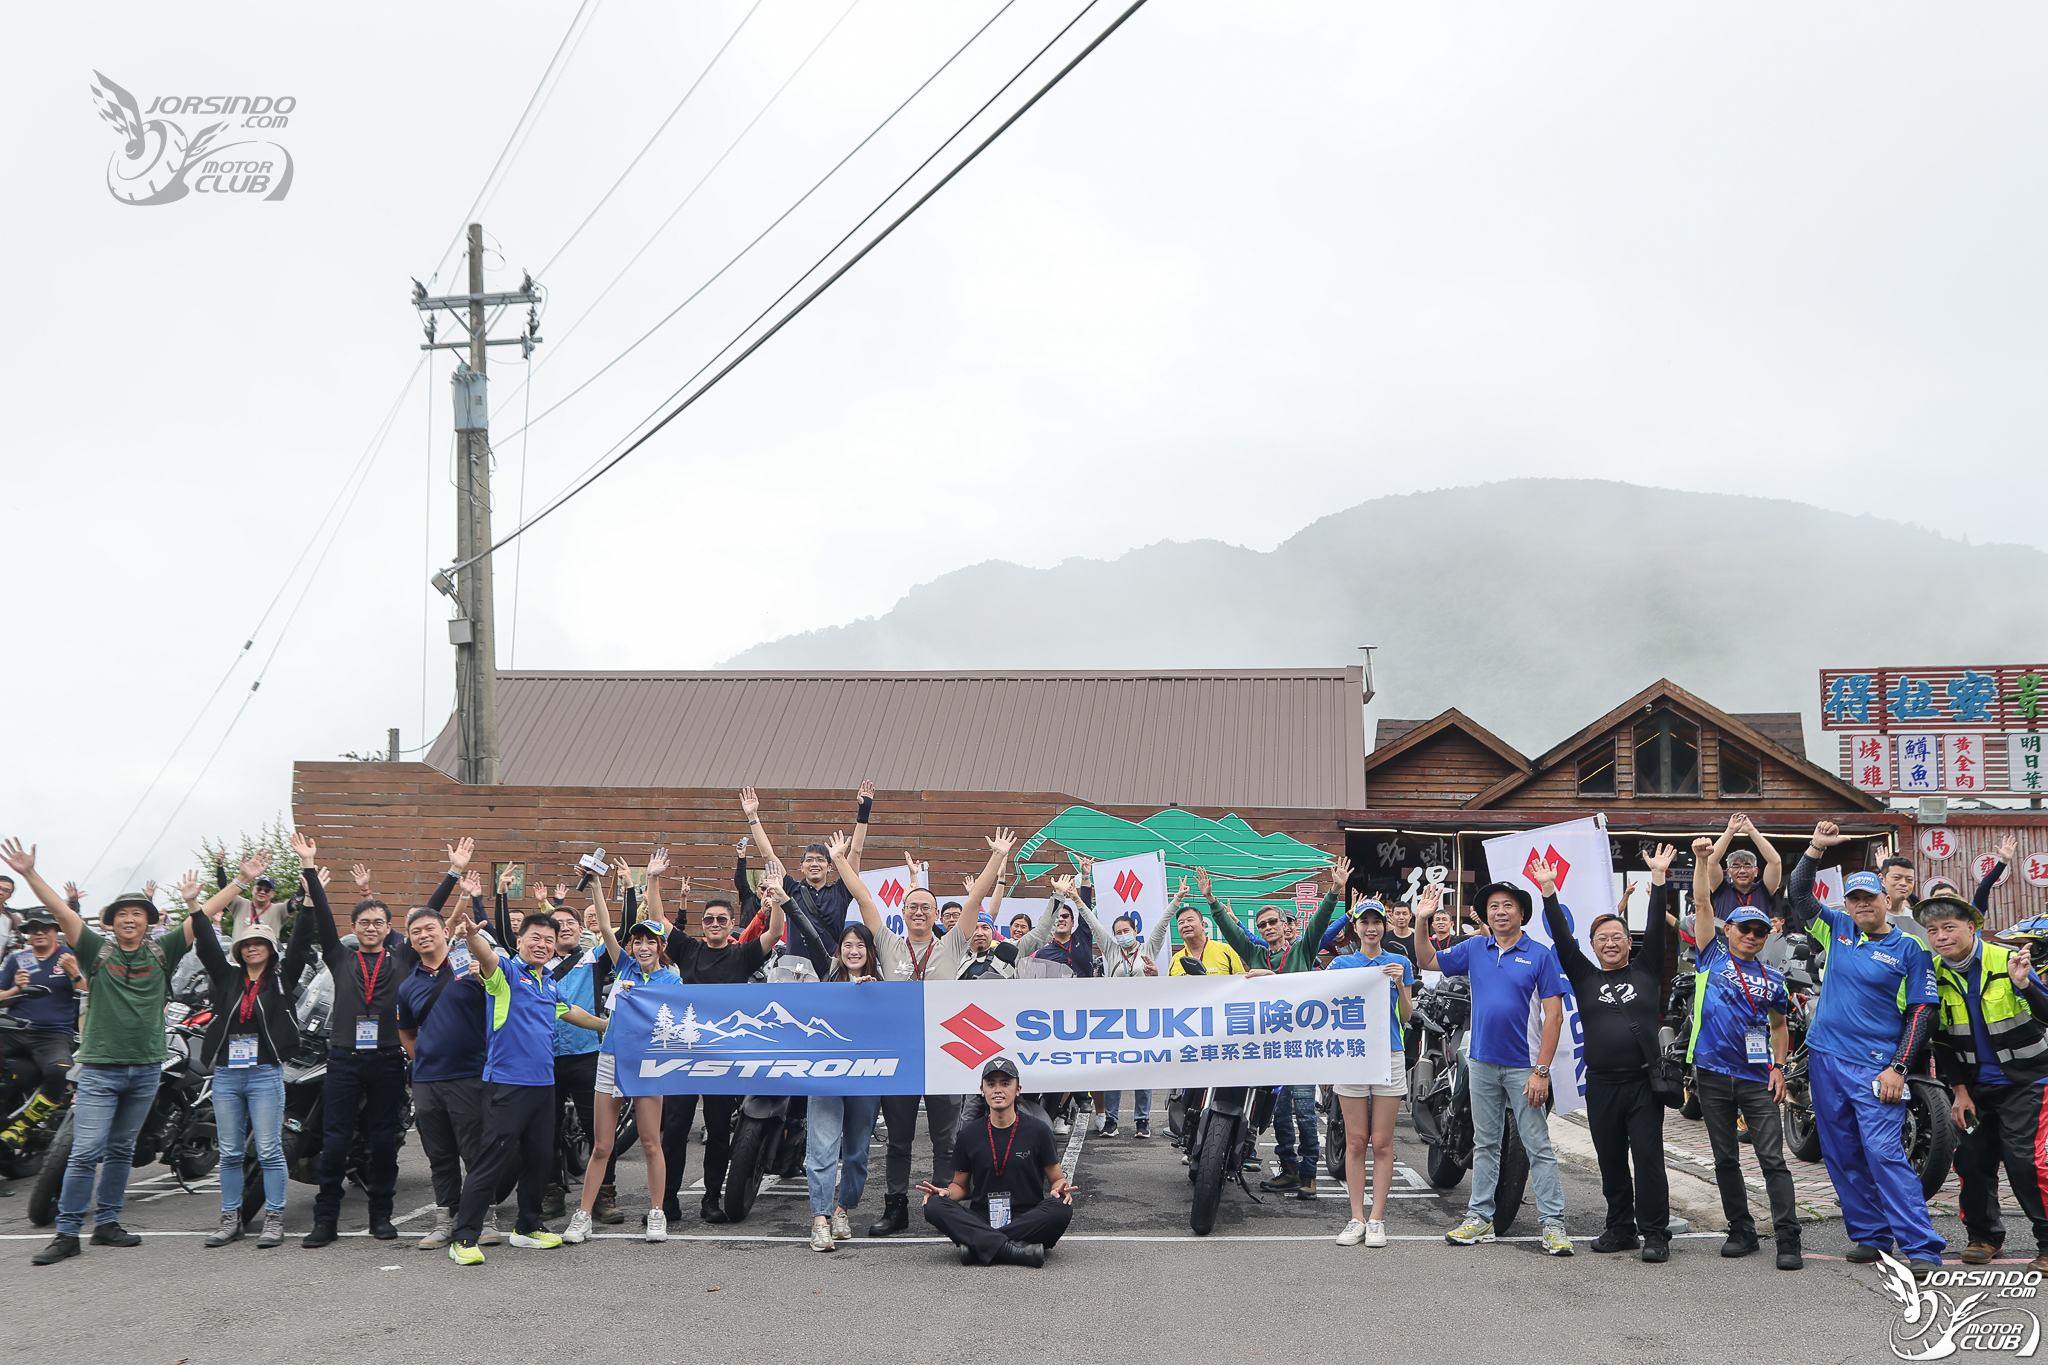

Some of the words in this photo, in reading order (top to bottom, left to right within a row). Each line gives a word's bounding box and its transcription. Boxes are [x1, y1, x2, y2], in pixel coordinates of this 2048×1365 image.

[1858, 737, 1884, 787] 烤雞
[1904, 736, 1931, 788] 鱒魚
[2020, 735, 2044, 790] 明日葉
[1015, 1007, 1214, 1042] SUZUKI
[1224, 995, 1367, 1037] 冒険の道
[638, 1057, 900, 1079] V-STROM
[1016, 1049, 1172, 1066] V-STROM
